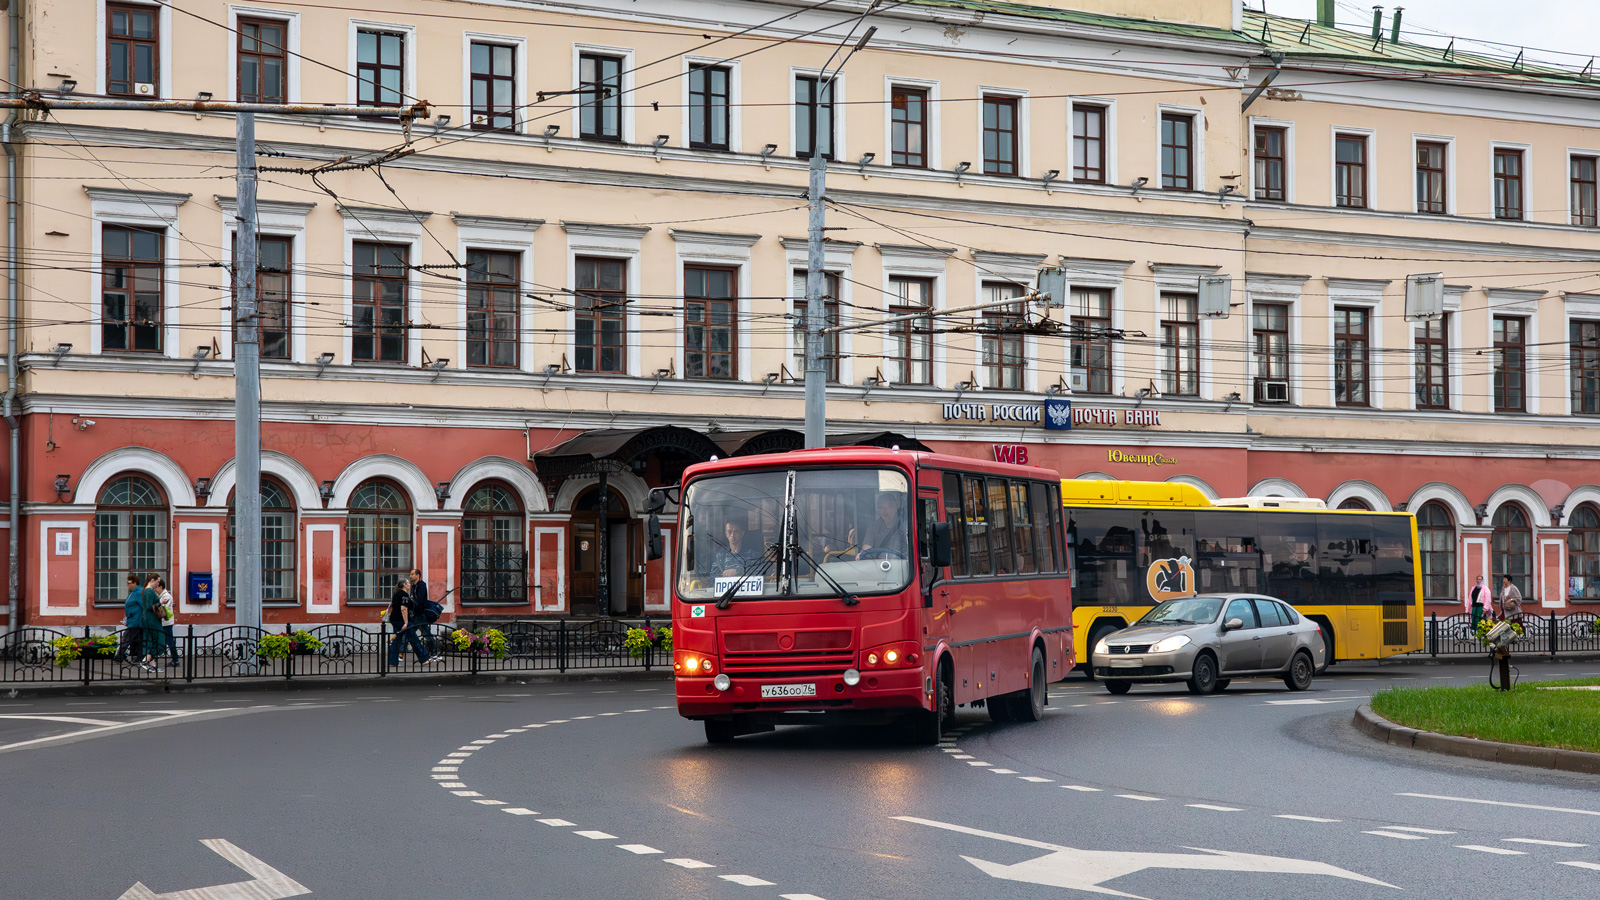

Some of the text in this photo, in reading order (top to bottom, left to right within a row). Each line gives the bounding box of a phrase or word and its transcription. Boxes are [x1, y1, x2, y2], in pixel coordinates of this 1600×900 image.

[942, 403, 1041, 423] ПОЧТА РОССИИ
[1073, 408, 1162, 426] ПОЧТА БАНК
[992, 444, 1029, 465] WB
